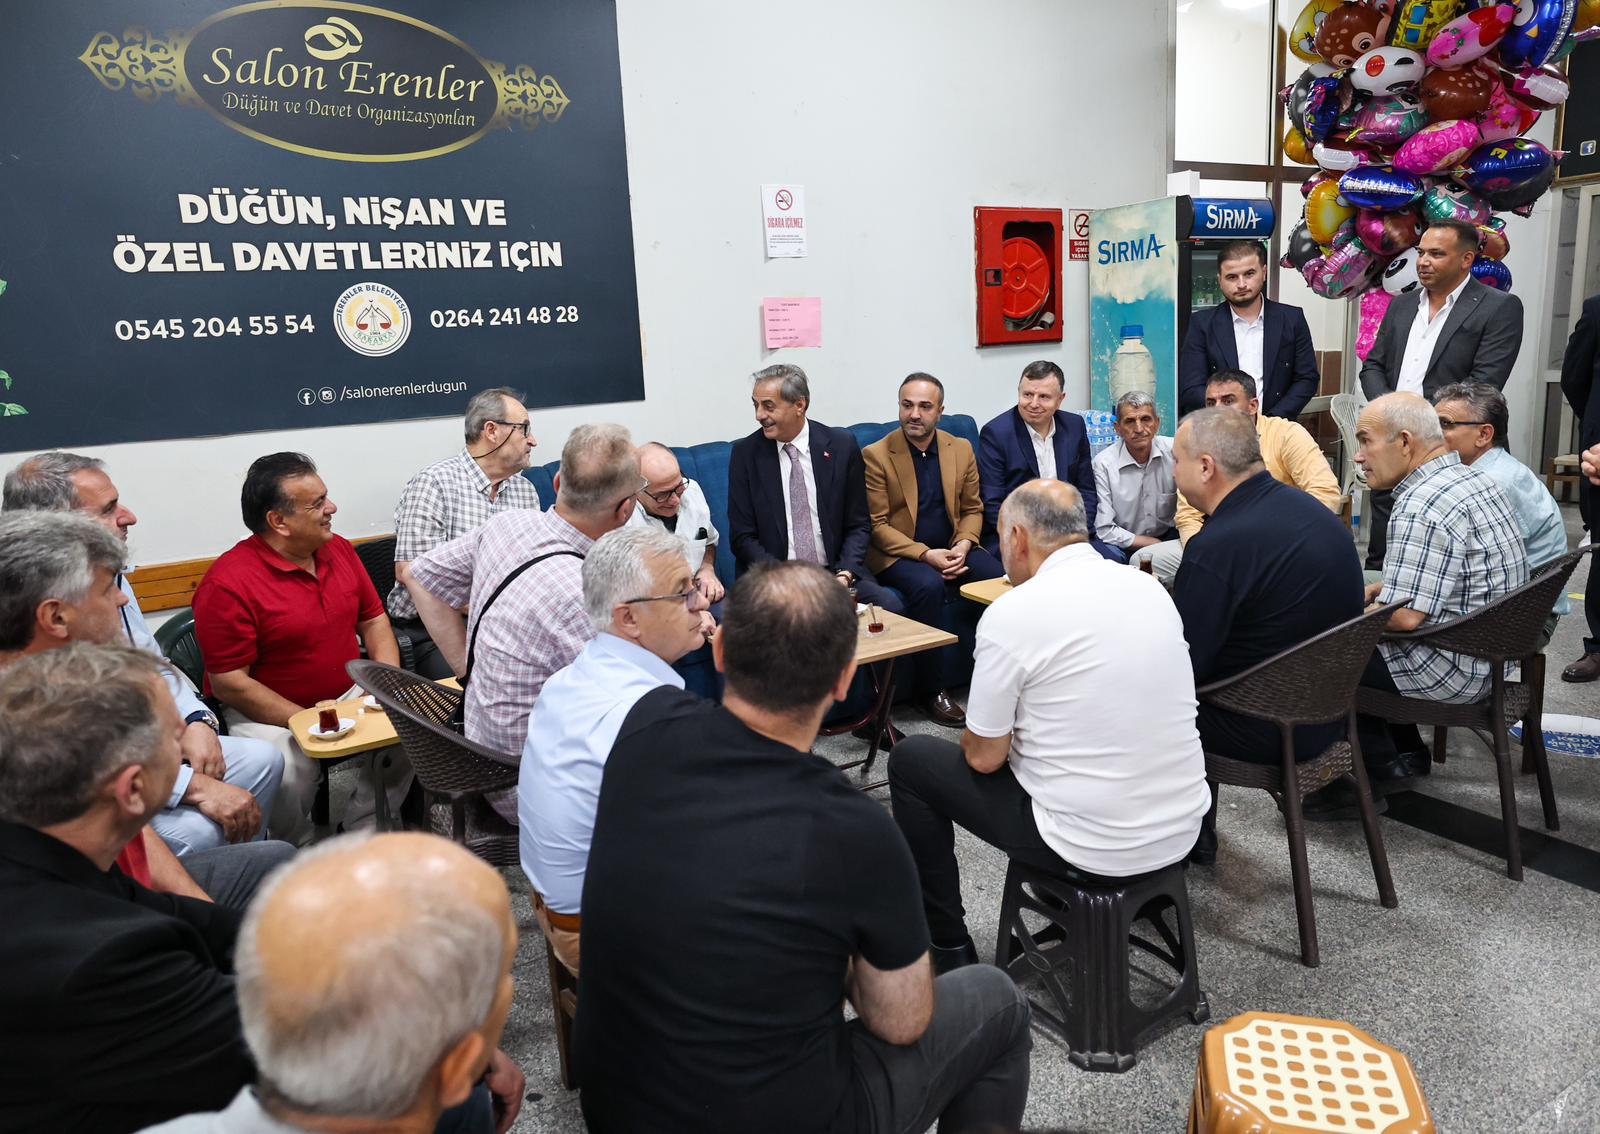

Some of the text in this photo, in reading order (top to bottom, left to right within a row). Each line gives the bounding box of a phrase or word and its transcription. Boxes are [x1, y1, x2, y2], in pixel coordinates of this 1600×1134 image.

[203, 47, 485, 102] Salon Erenler
[222, 92, 476, 129] Düğün ve Davet Organizasyonları
[178, 188, 336, 230] DÜĞÜN,
[461, 199, 507, 226] VE
[1206, 204, 1263, 230] SIRMA
[113, 235, 226, 273] ÖZEL
[1098, 233, 1167, 265] SIRMA
[337, 286, 364, 313] ERENLER
[114, 314, 315, 341] 0545 204 55 54
[430, 305, 579, 329] 0264 241 48 28
[340, 380, 467, 401] /salonerenlerdugun
